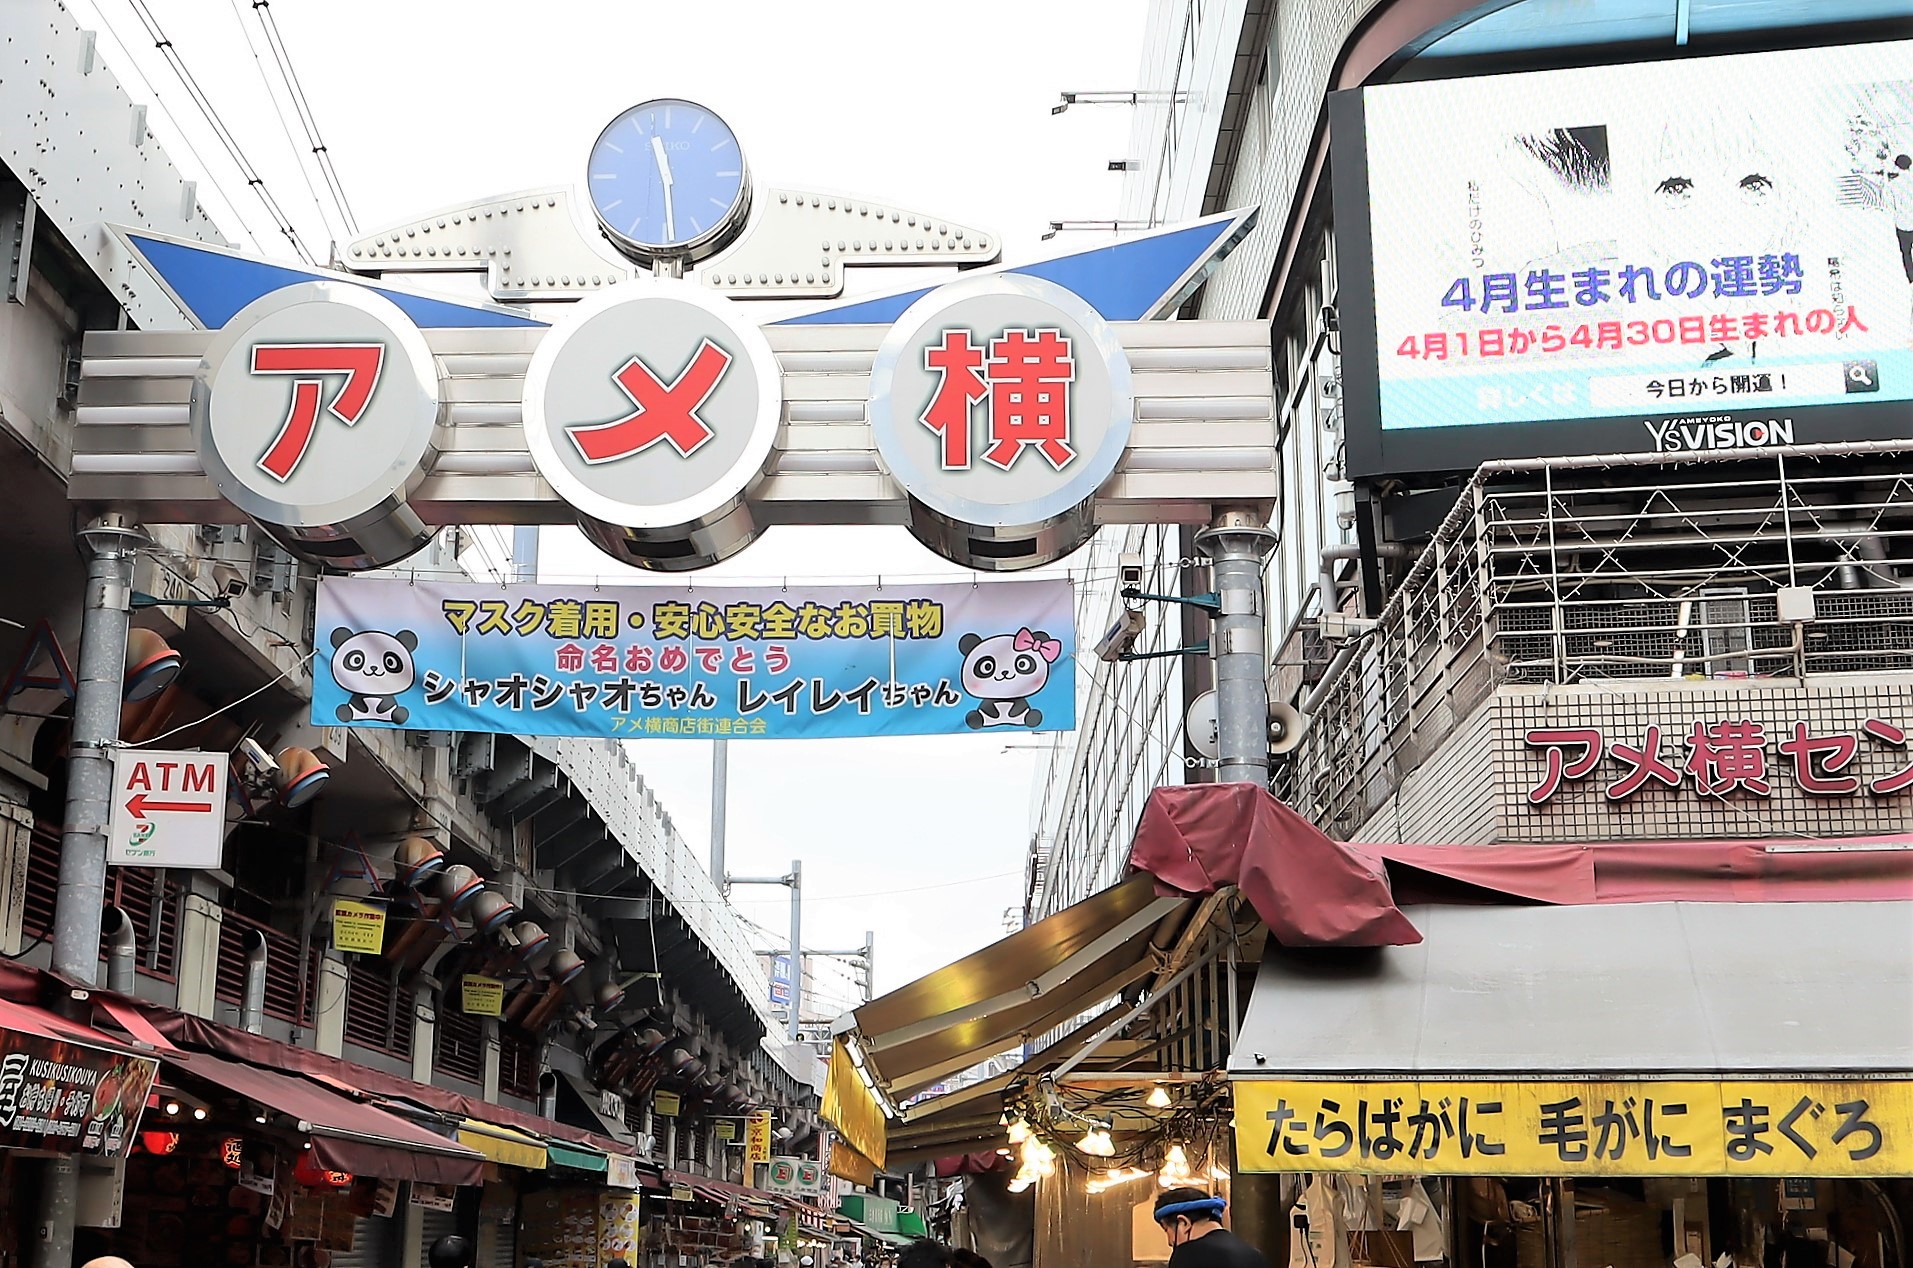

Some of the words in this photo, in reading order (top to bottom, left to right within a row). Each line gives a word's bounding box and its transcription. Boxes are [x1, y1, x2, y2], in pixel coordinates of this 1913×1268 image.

[644, 141, 690, 152] SIKO
[1441, 252, 1804, 314] 4月生まれの運勢
[1396, 307, 1868, 361] 4月1日から4月30日生まれの人
[247, 325, 1078, 485] アメ横
[1679, 415, 1732, 425] AMEYOKO
[441, 599, 944, 641] マスク着用・安心安全なお買物
[555, 643, 791, 674] 命名おめでとう
[423, 672, 716, 714] シャオシャオちゃん
[737, 678, 960, 716] レイレイちゃん
[610, 715, 768, 736] アメ横商店街連合会
[126, 762, 215, 792] ATM
[1524, 717, 1913, 805] アメ横セン
[29, 1058, 99, 1087] KUSIKUSIKOUYA
[1265, 1096, 1506, 1159] たらばがに
[1537, 1096, 1692, 1162] 毛がに
[1721, 1095, 1883, 1161] まぐろ
